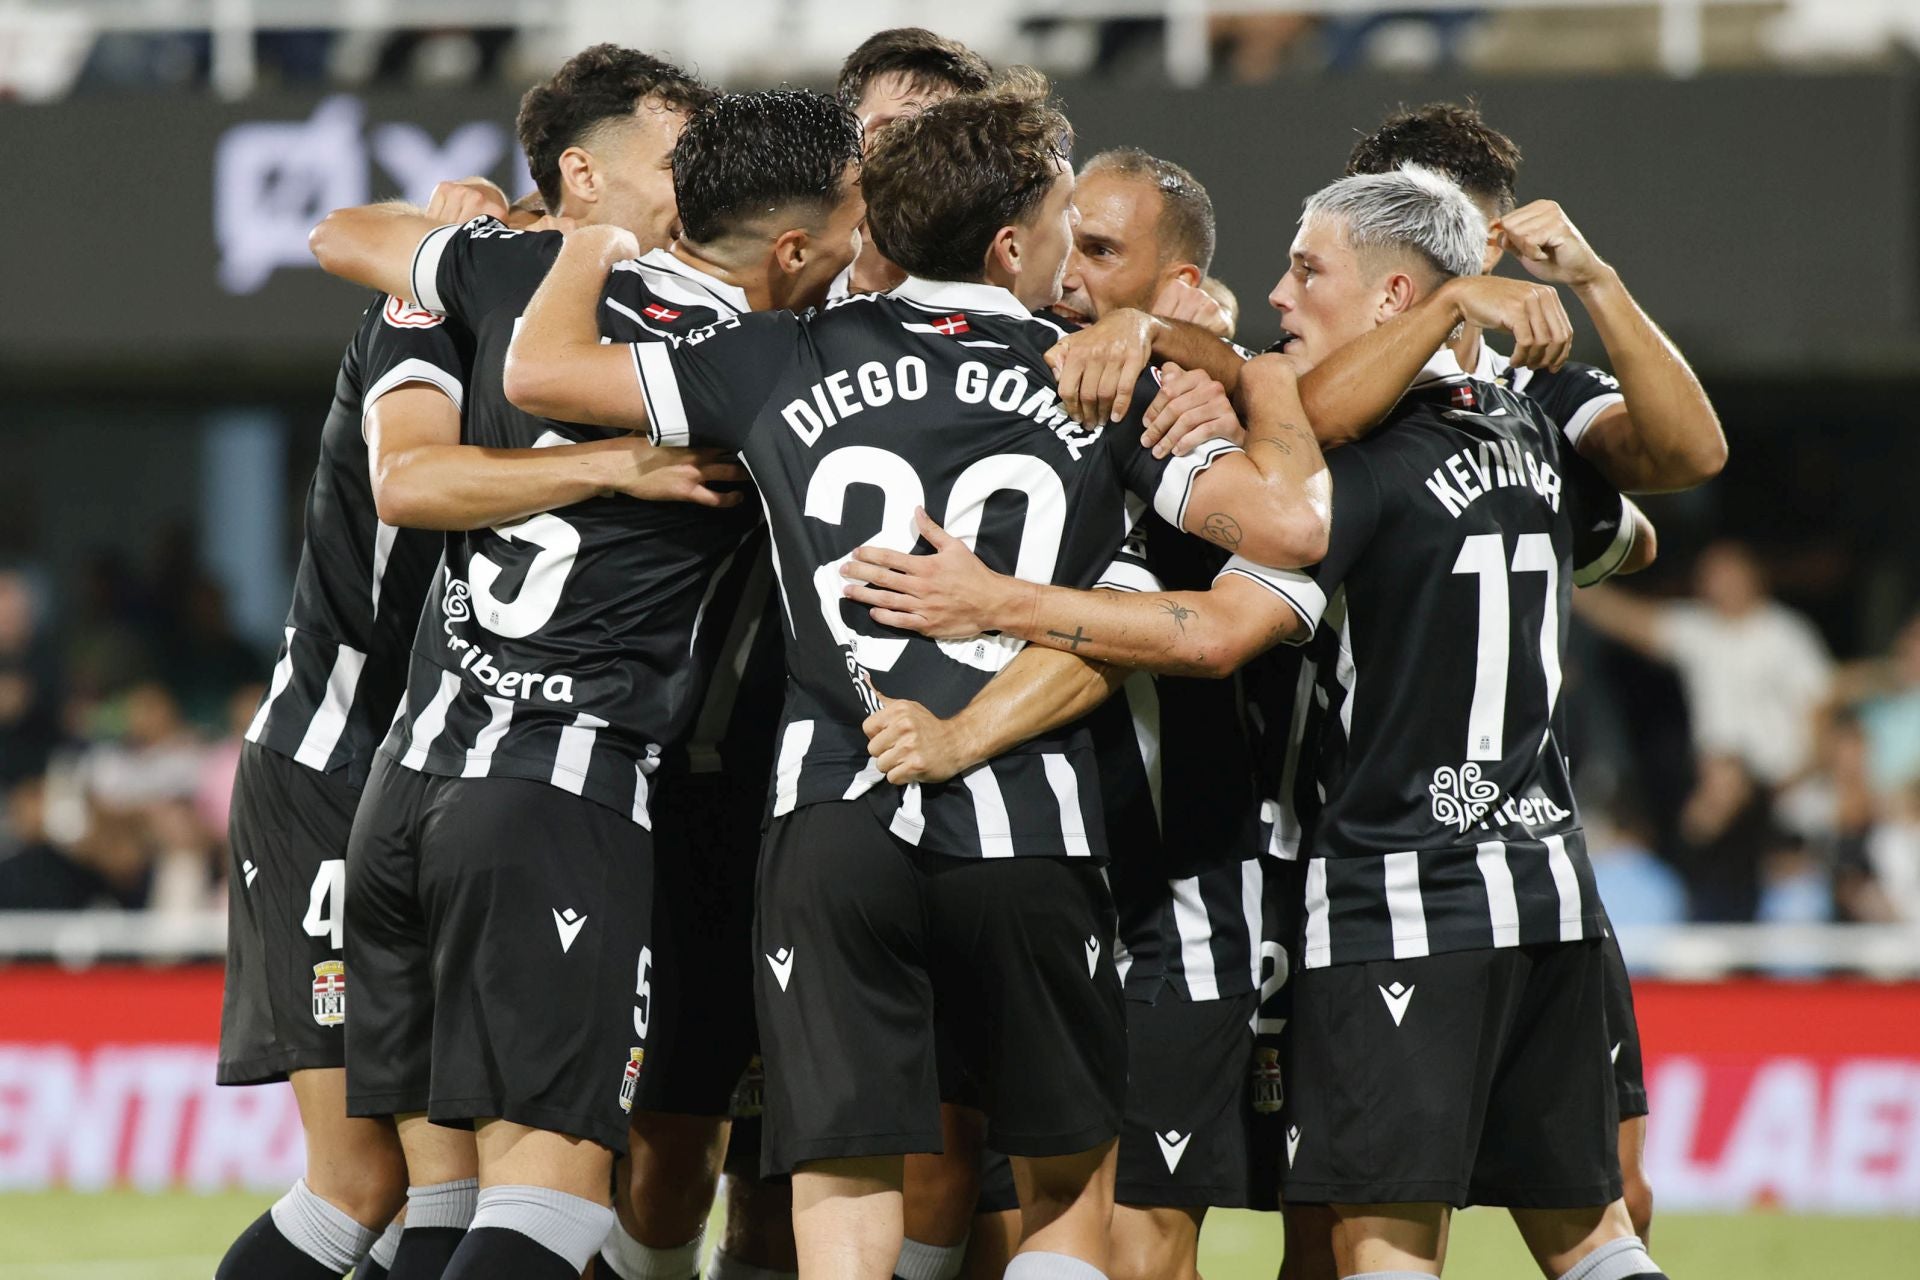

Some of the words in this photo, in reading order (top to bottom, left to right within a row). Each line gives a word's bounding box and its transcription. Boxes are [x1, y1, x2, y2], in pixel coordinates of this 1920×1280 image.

[781, 355, 928, 448] DIEGO
[1425, 439, 1528, 519] KEVIN
[804, 445, 1067, 672] 20
[447, 634, 574, 703] ribera
[303, 859, 345, 950] 4
[633, 945, 652, 1041] 5
